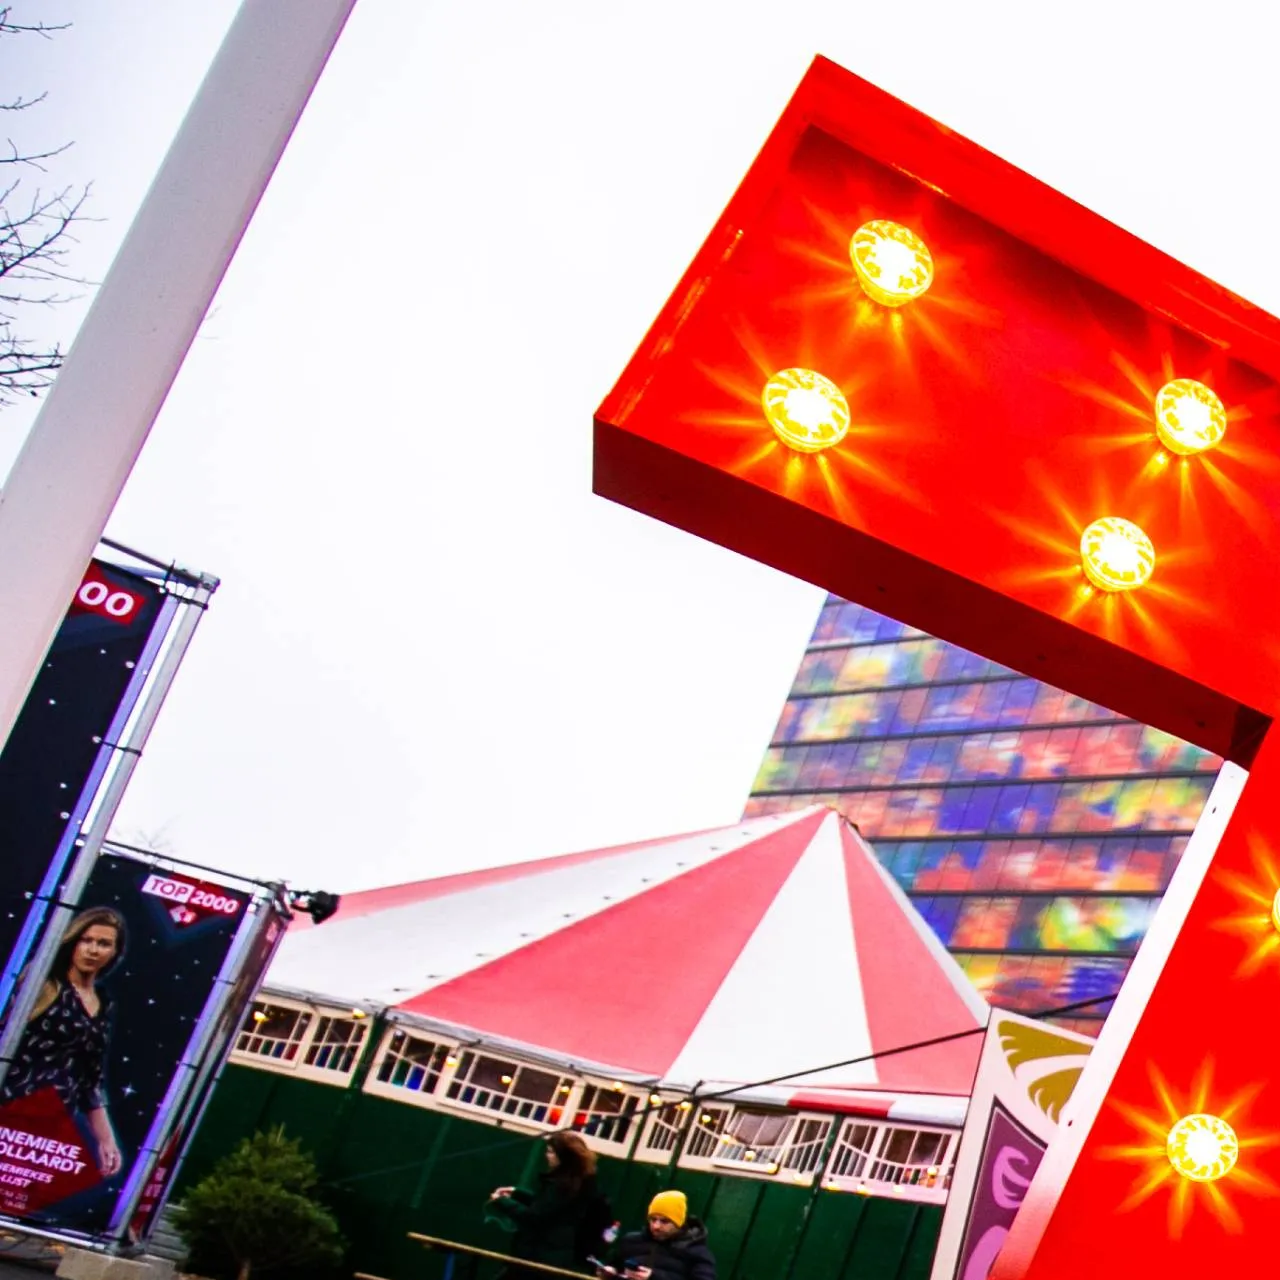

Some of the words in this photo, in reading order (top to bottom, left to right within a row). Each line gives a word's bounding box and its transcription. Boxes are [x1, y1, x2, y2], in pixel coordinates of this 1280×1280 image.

[151, 878, 189, 898] TOP
[190, 890, 240, 914] 2000
[0, 1126, 83, 1160] NEMIEKE
